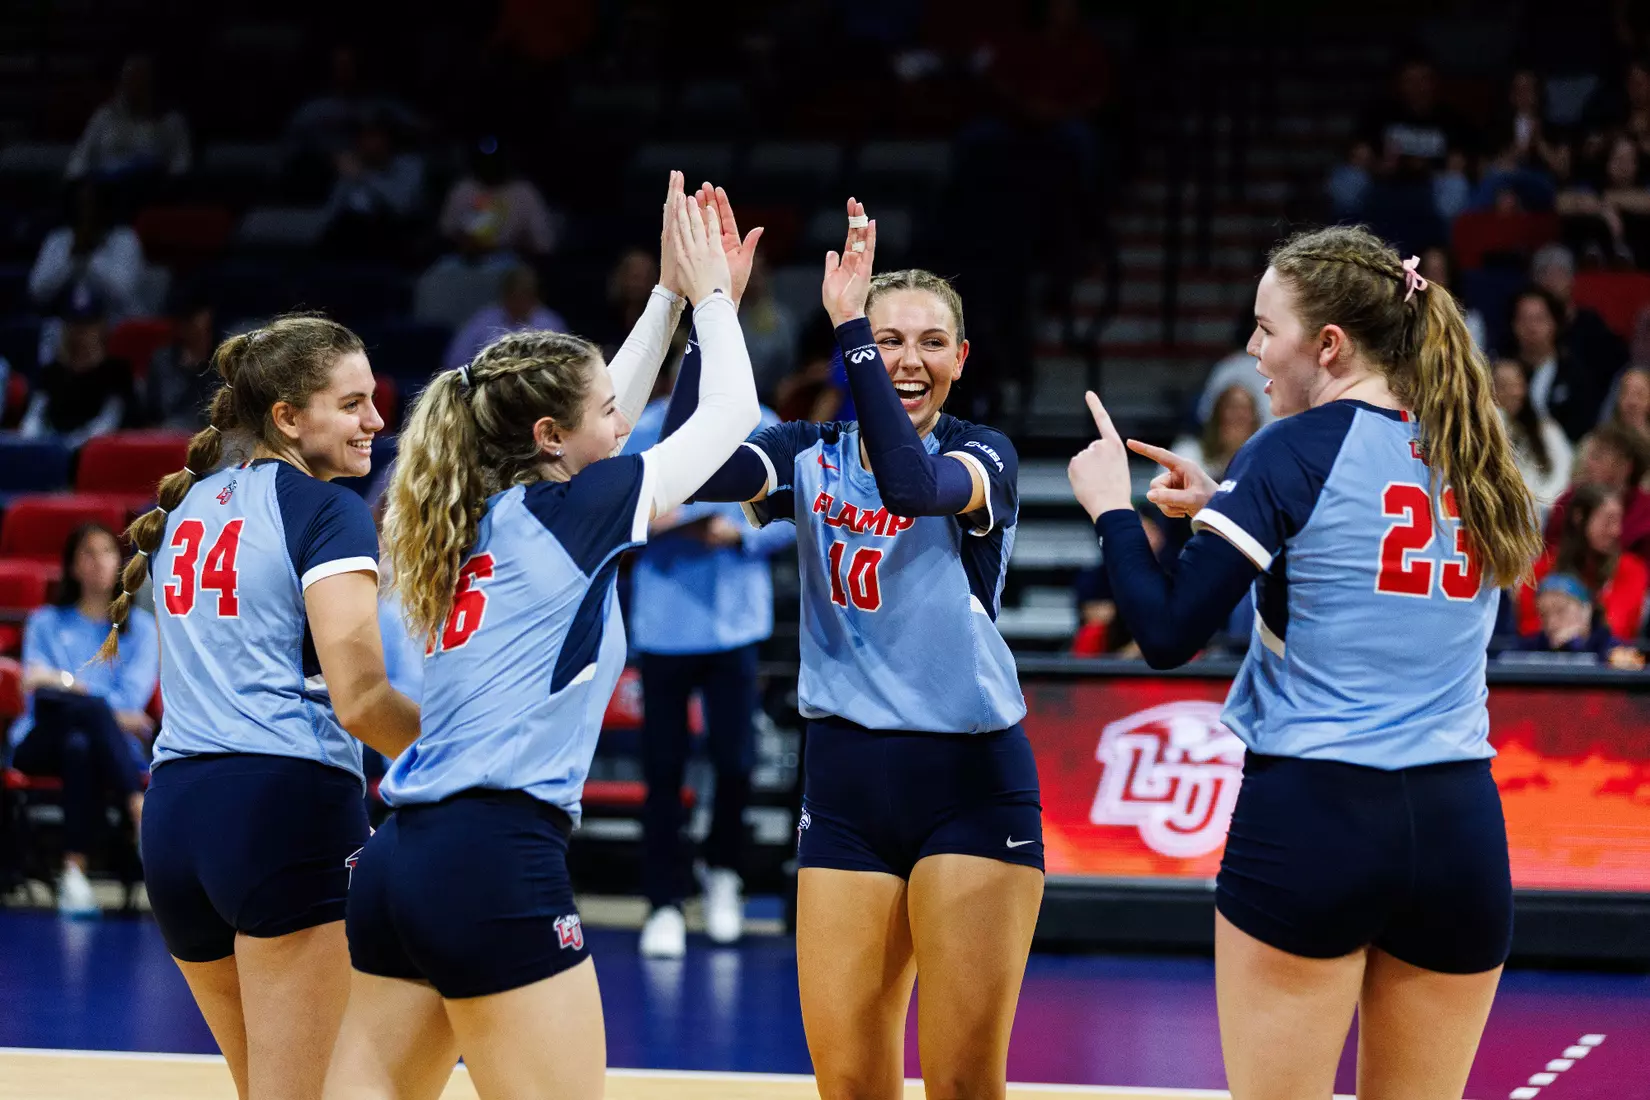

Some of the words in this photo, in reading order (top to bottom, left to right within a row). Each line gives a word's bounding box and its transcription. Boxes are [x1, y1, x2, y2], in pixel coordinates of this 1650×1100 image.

[162, 516, 246, 619] 34
[828, 540, 885, 613] 10
[1374, 480, 1485, 602] 23
